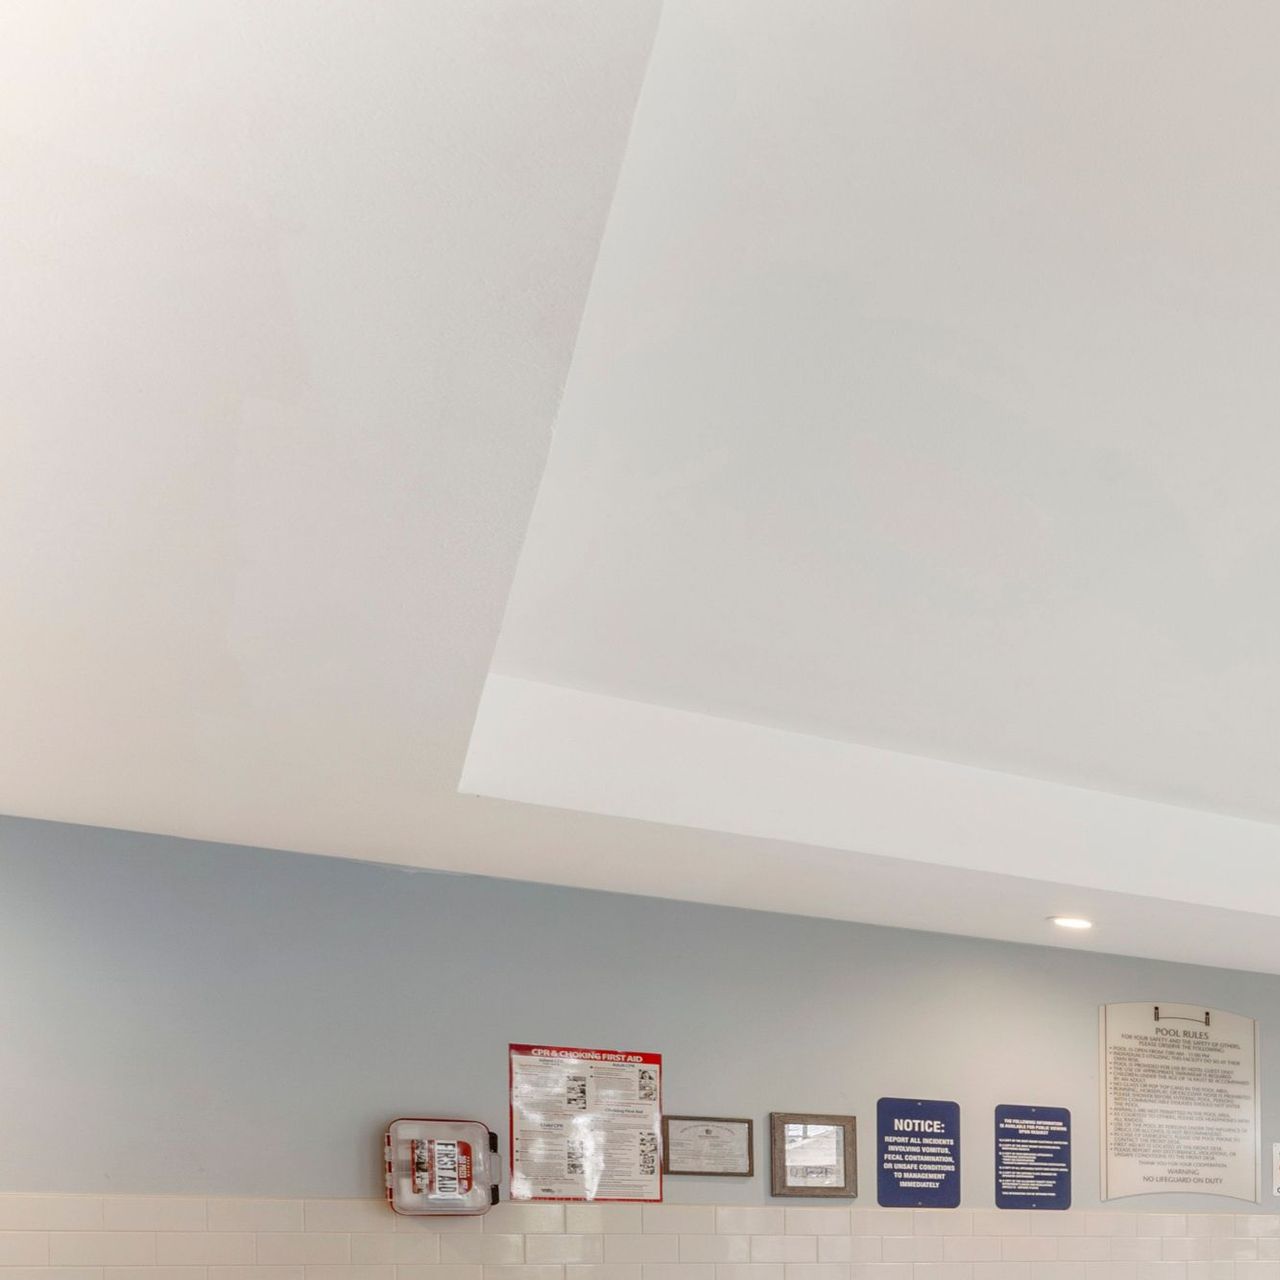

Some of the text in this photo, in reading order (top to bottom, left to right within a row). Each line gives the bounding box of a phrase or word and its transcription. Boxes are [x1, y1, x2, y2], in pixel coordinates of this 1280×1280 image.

[1155, 1027, 1209, 1040] POOL RULES
[560, 1051, 600, 1060] CHOKING
[602, 1053, 626, 1061] FIRST
[894, 1119, 945, 1132] NOTICE:
[437, 1143, 457, 1193] FIRST AID
